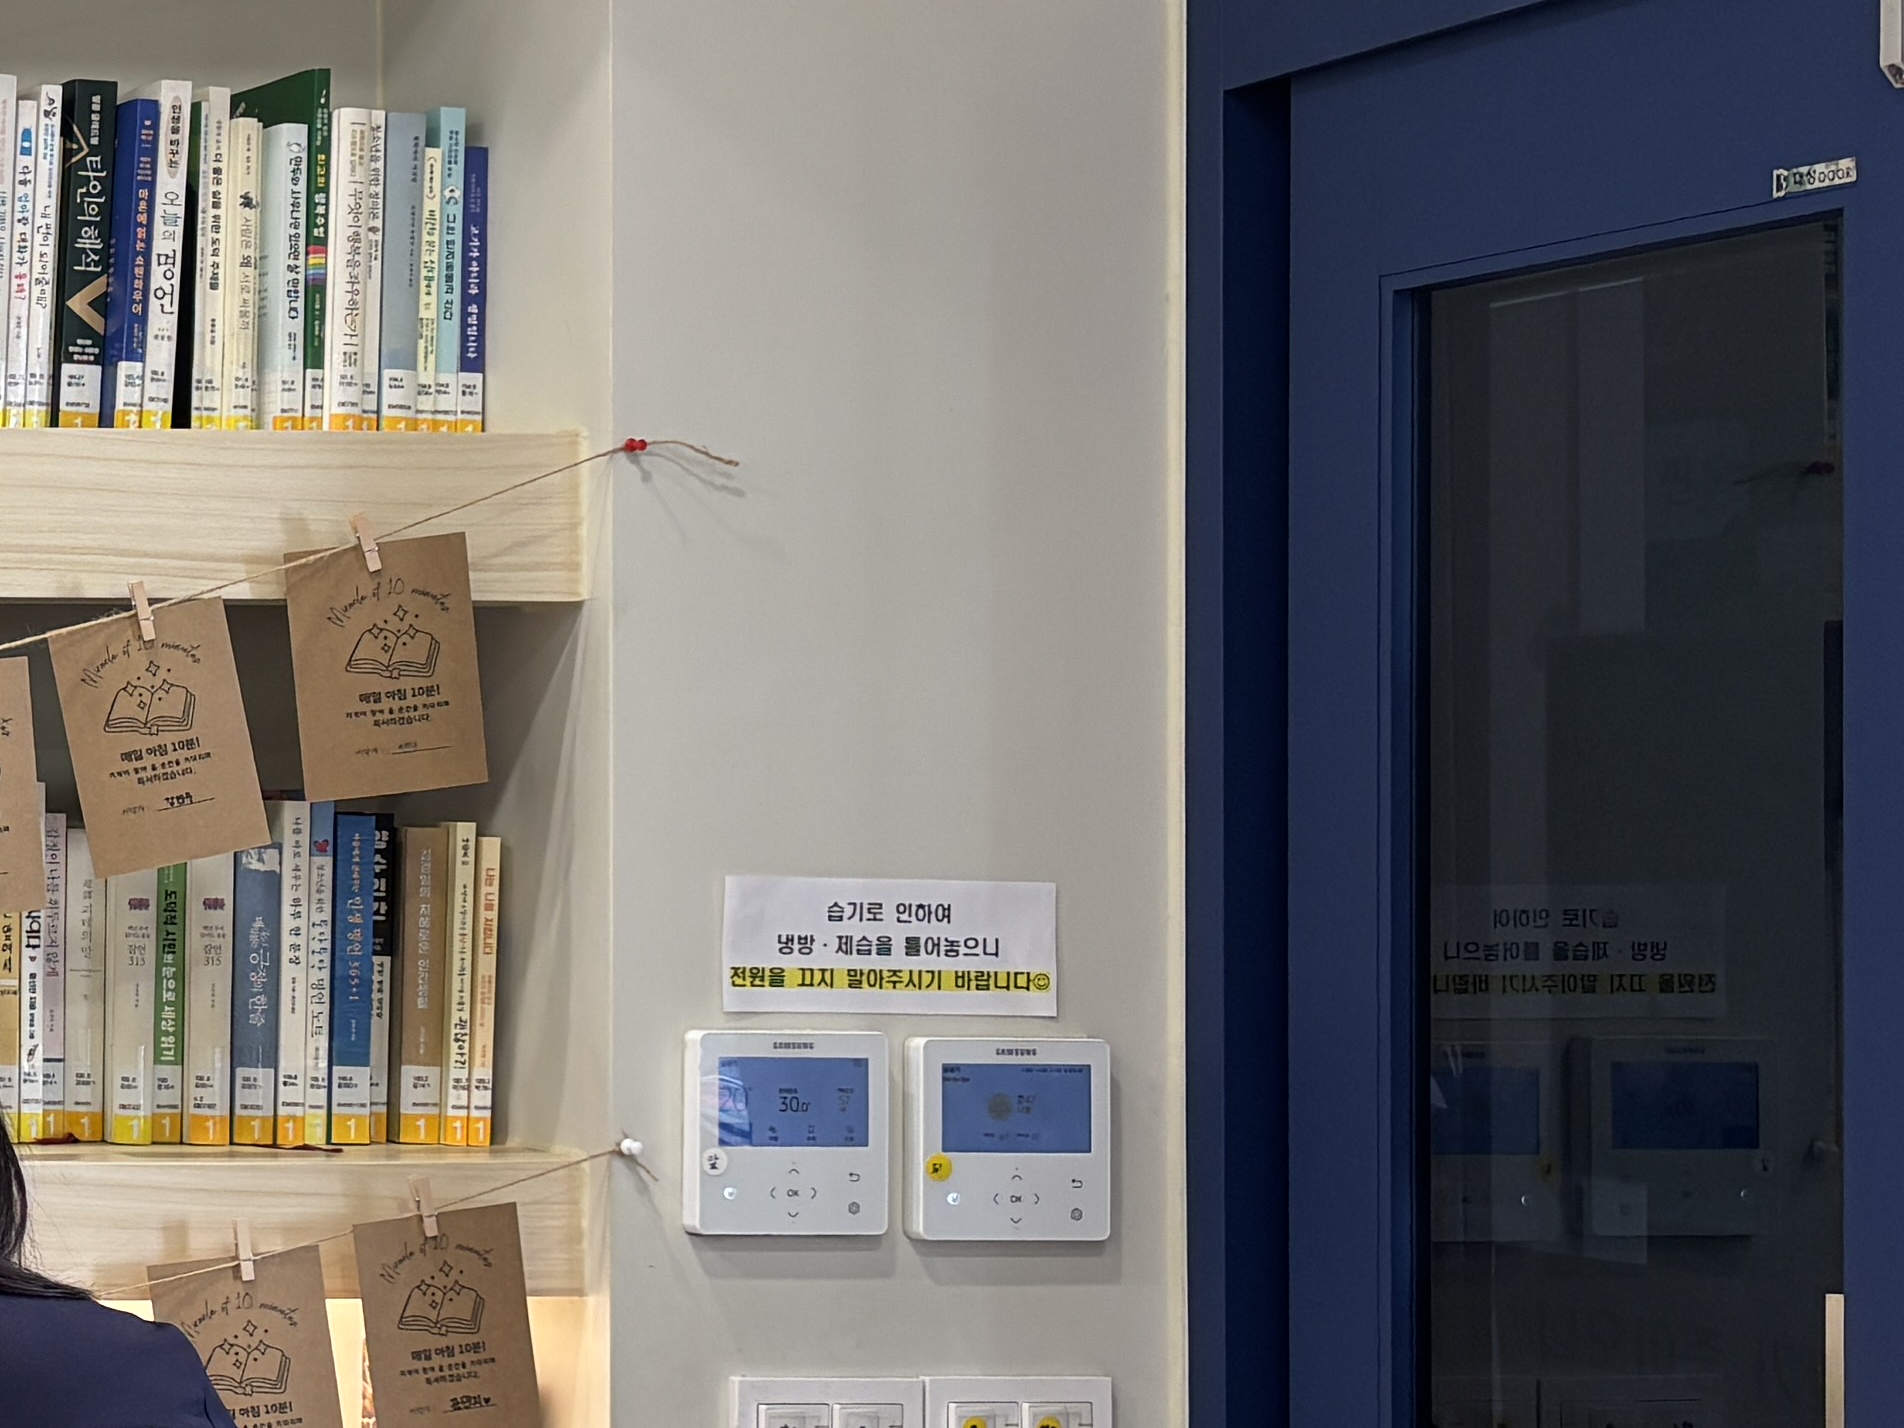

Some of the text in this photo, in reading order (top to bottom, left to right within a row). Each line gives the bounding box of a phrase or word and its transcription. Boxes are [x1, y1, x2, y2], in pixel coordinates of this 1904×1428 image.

[73, 156, 105, 271] 타인의 해석
[827, 901, 952, 924] 습기로 인하여
[777, 934, 815, 956] 냉방
[836, 935, 893, 956] 제습을
[160, 889, 176, 1061] 도덕적 시민의 눈으로 세상 읽기
[729, 966, 1031, 991] 전원을 끄지 말아주시기 바랍니다
[773, 1041, 814, 1050] SAMSUNG
[996, 1047, 1037, 1056] SAMSUNG
[787, 1189, 800, 1197] OK
